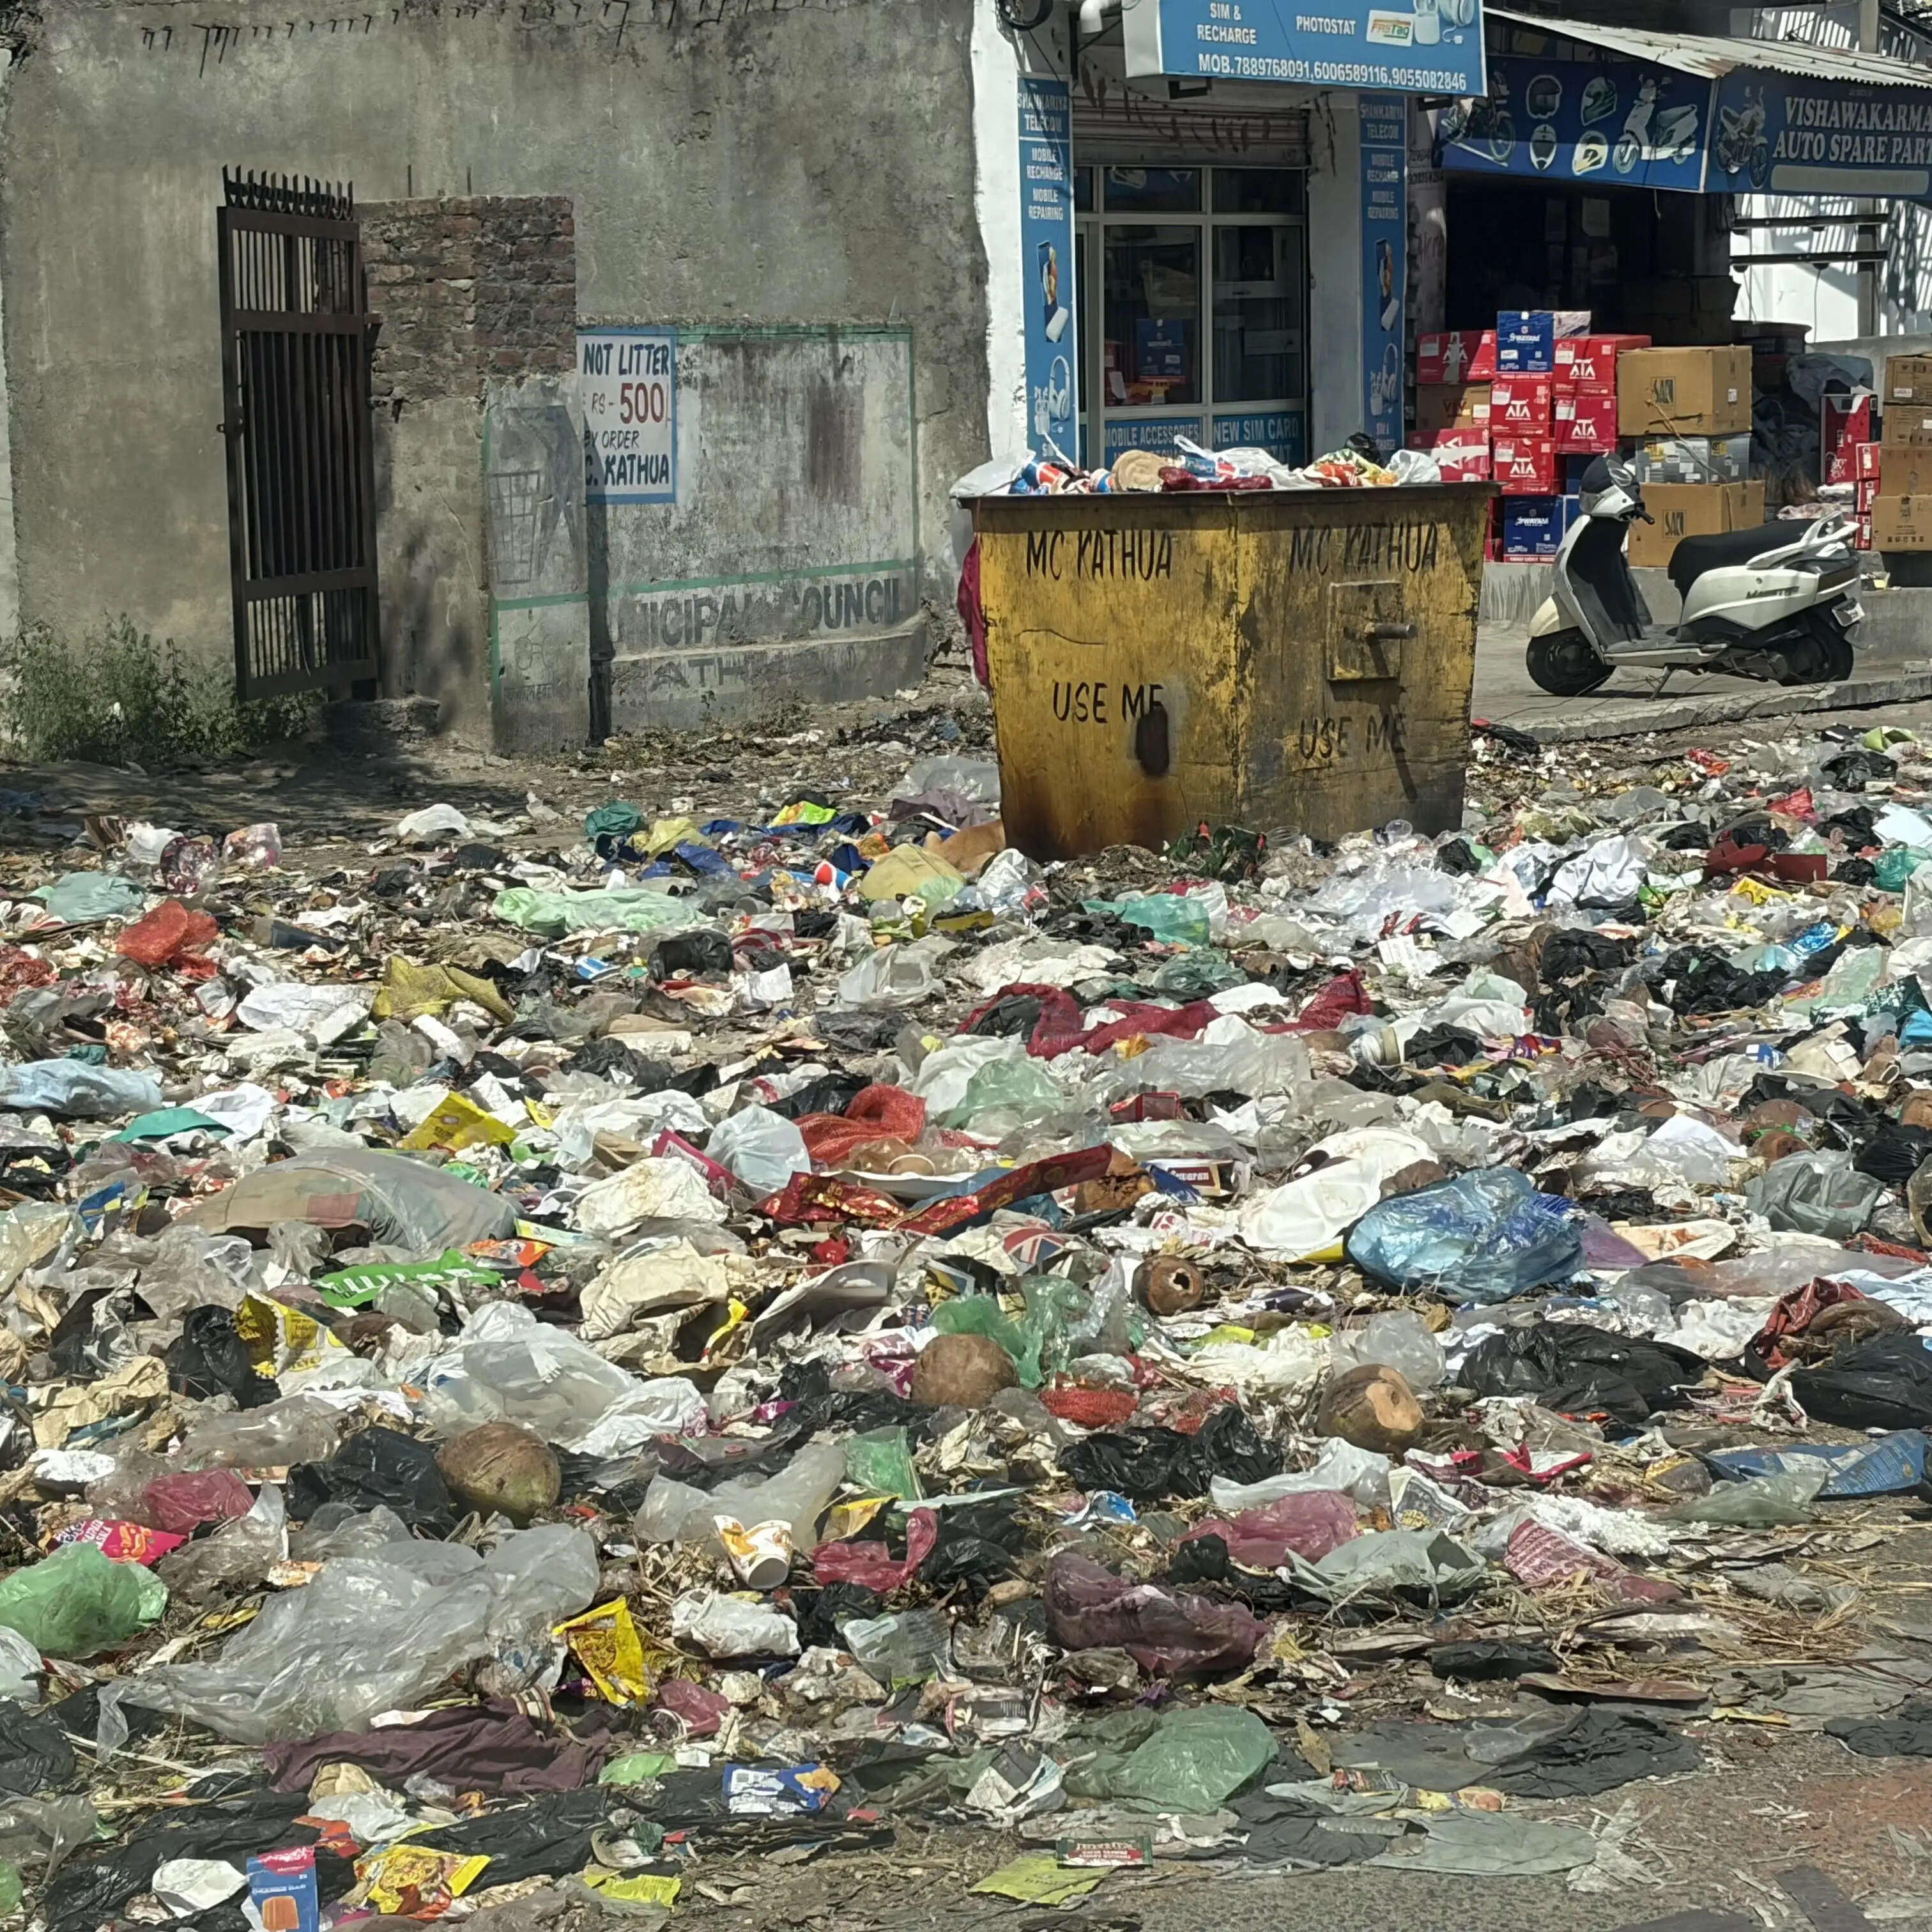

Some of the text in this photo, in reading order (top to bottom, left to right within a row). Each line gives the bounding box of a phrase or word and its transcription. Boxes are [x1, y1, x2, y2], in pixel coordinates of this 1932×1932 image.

[1210, 3, 1241, 20] SIM &
[1197, 24, 1257, 45] RECHARGE
[1296, 15, 1356, 35] PHOTOSTAT
[1025, 114, 1062, 132] TELECOM
[1785, 97, 1932, 132] VISHAWAKARMA
[1032, 148, 1057, 162] MOBILE
[1772, 131, 1825, 160] AUTO
[1829, 134, 1888, 163] SPARE
[1027, 165, 1063, 181] RECHARGE
[1033, 187, 1058, 203] MOBILE
[1029, 206, 1063, 220] REPAIRING
[584, 343, 670, 376] NOT LITTER
[592, 392, 606, 415] RS
[1505, 399, 1531, 418] ATA
[1105, 424, 1199, 447] MOBILE ACCESSORIES
[1213, 418, 1298, 444] NEW SIM CARD
[1571, 418, 1597, 436] ATA
[584, 430, 640, 450] BY ORDER
[604, 454, 670, 486] KATHUA
[1510, 456, 1537, 475] ATA
[1027, 529, 1172, 581] MC KATHUA
[1289, 519, 1438, 576] MC KATHUA
[1053, 681, 1164, 723] USE ME
[1300, 712, 1407, 760] USE ME
